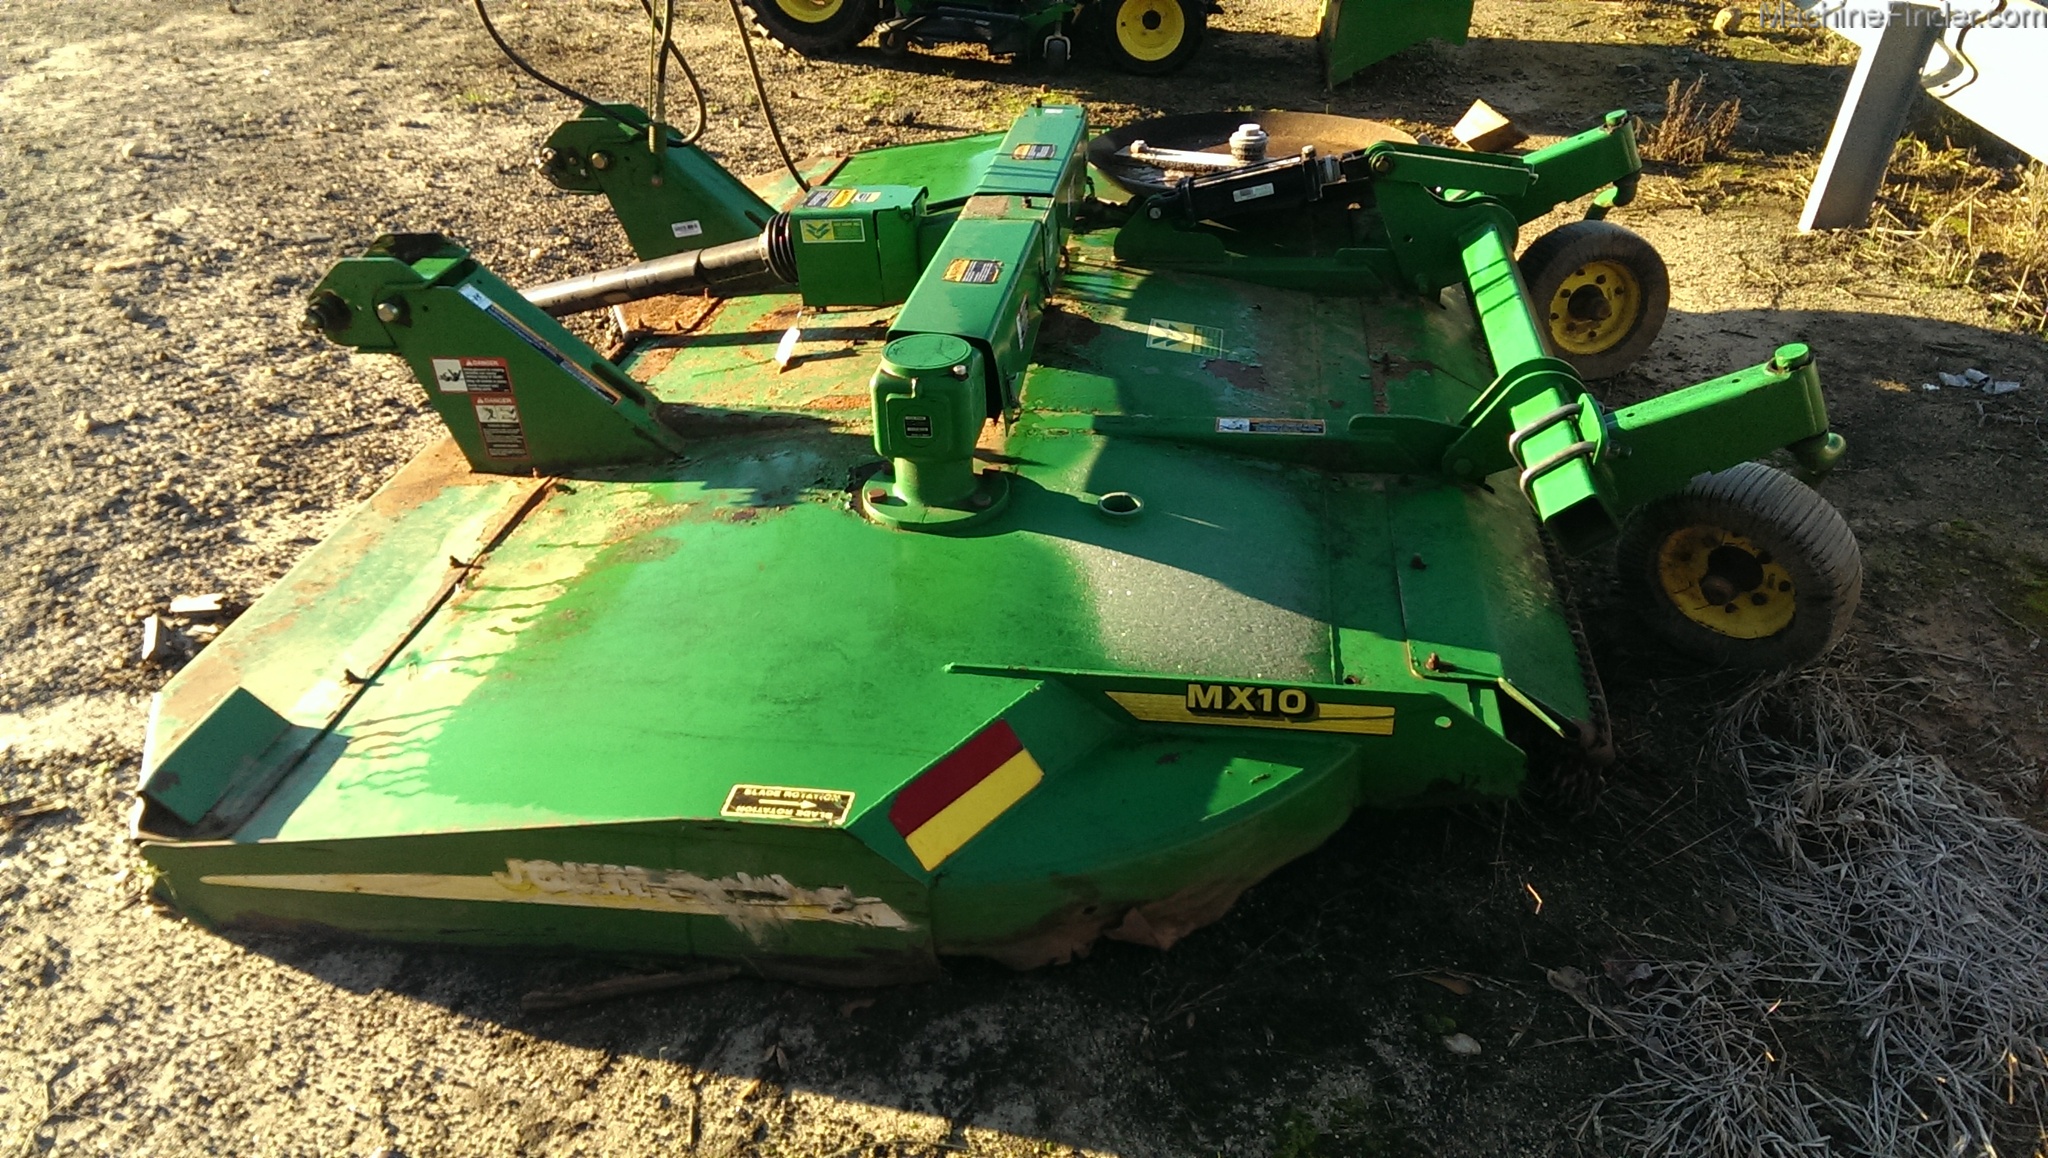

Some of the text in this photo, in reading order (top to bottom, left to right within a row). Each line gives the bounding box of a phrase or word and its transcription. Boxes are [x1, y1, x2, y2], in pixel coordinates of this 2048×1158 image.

[1187, 683, 1308, 714] MX10
[743, 788, 841, 802] BLADE ROTATION
[736, 806, 833, 820] BLADE ROTATION
